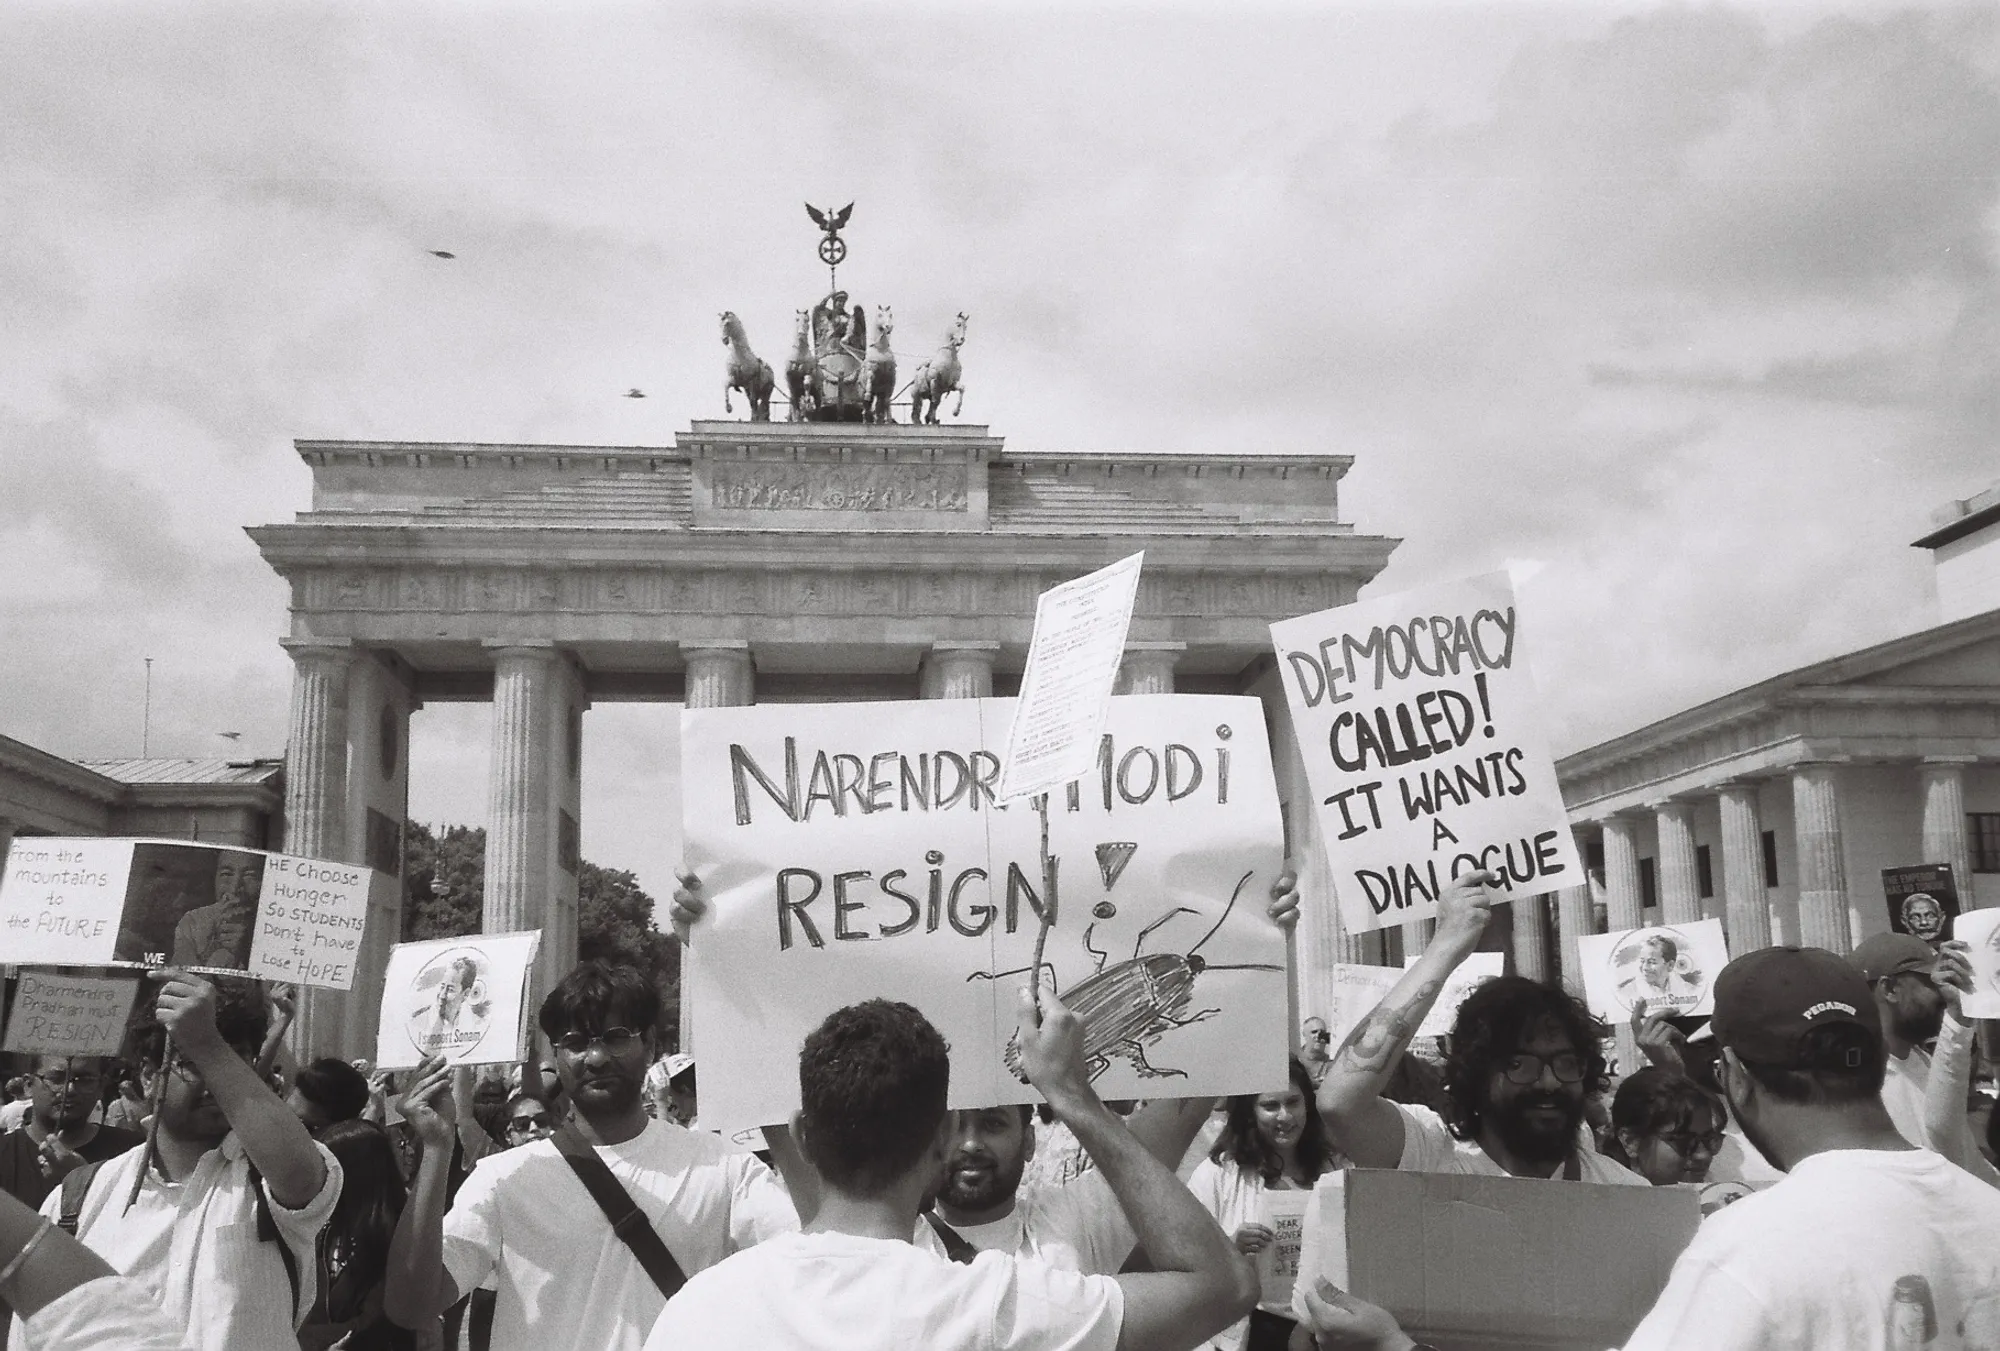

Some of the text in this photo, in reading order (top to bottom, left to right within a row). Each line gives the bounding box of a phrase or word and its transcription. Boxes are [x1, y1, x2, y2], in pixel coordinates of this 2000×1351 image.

[1287, 606, 1515, 708] DEMOCRACY
[1329, 672, 1495, 772] CALLED!
[730, 736, 1042, 826] NARENDR
[1324, 747, 1527, 840] IT WANTS
[1433, 817, 1459, 850] A
[56, 849, 83, 863] the
[269, 859, 291, 872] HE
[15, 868, 108, 887] mountains
[46, 891, 64, 906] to
[274, 882, 348, 908] Hunger
[7, 911, 108, 938] the FUTURE
[289, 908, 364, 931] STUDENTS
[143, 951, 165, 965] WE
[297, 959, 349, 985] HOPE
[21, 977, 115, 1001] Dharmendra
[1668, 993, 1698, 1005] Sonam
[21, 996, 86, 1017] Pradhan
[26, 1016, 113, 1049] RESIGN
[454, 1028, 481, 1043] Sonam
[1276, 1219, 1298, 1231] DEAR
